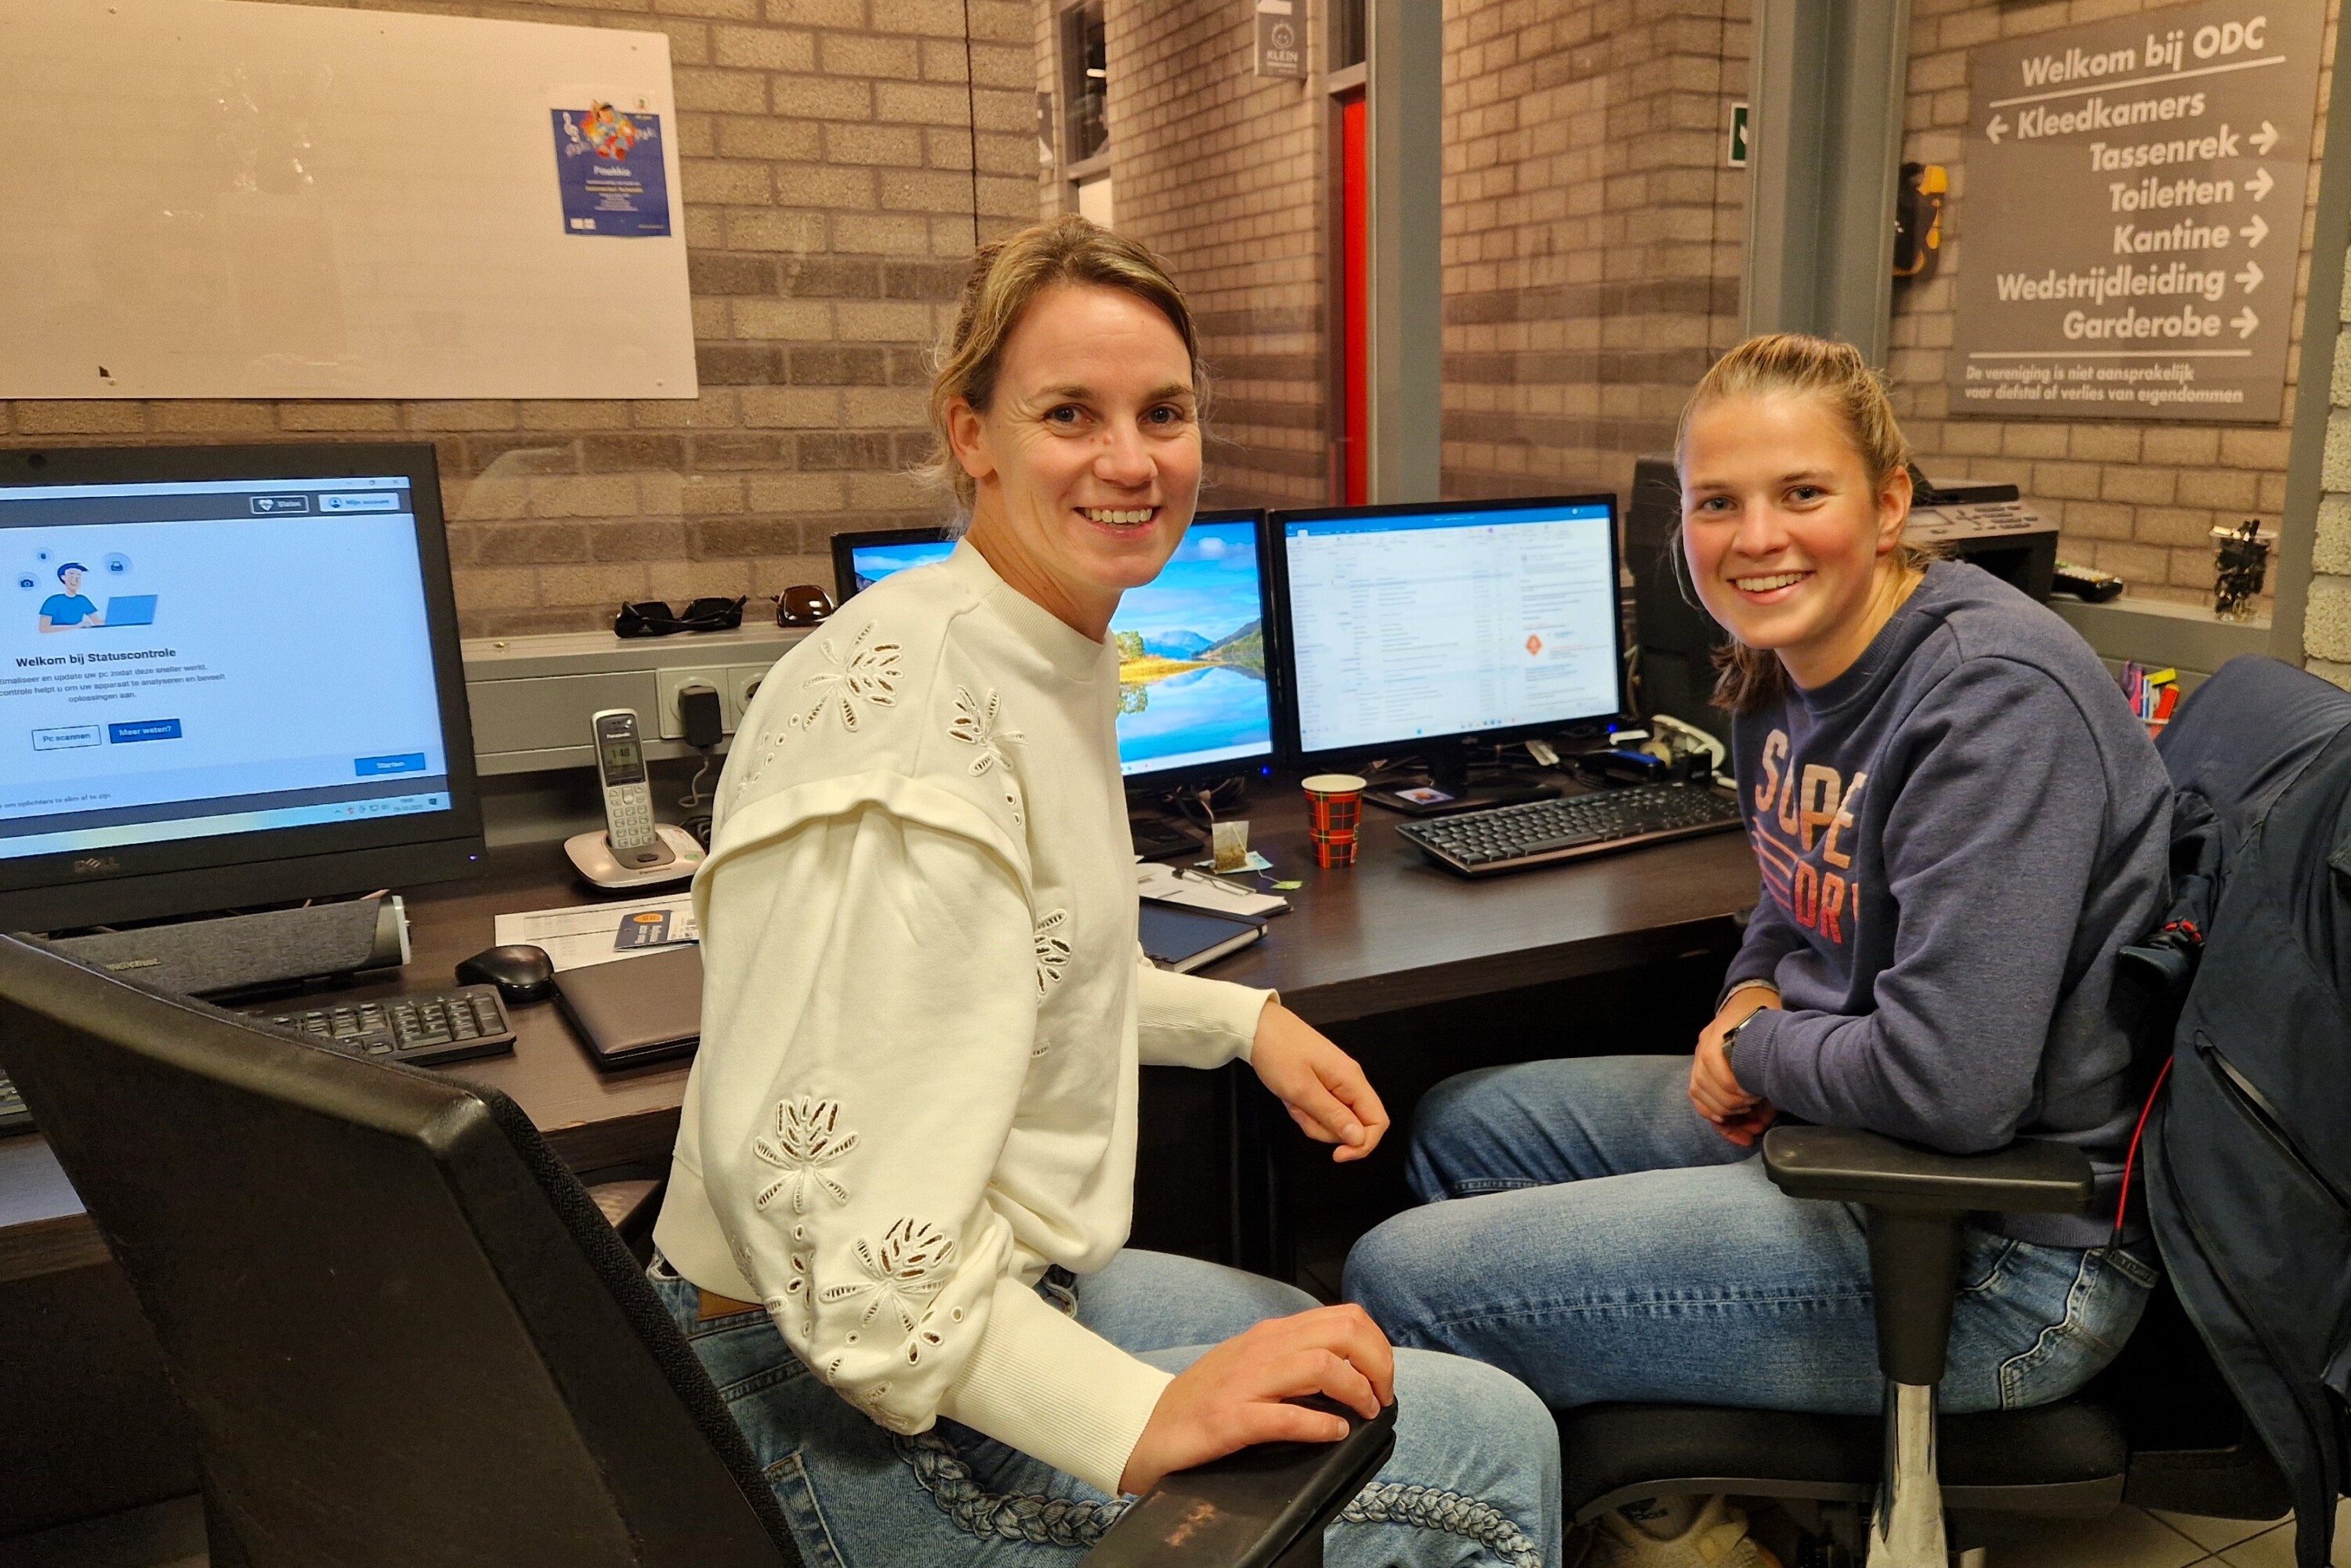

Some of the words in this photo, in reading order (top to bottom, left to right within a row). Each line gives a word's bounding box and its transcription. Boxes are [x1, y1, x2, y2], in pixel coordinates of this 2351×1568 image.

[1266, 50, 1299, 62] KLEIN
[2022, 48, 2135, 86] Welkom
[2144, 29, 2184, 71] bij
[2193, 16, 2267, 59] ODC
[2017, 92, 2206, 139] Kleedkamers
[2089, 123, 2240, 172] Tassenrek
[2109, 179, 2233, 212] Toiletten
[2113, 218, 2230, 254] Kantine
[1997, 262, 2226, 305] Wedstrijdleiding
[2063, 304, 2222, 339] Garderobe
[1965, 365, 1981, 380] De
[1985, 364, 2051, 384] vereniging
[2053, 364, 2064, 380] is
[2067, 364, 2094, 380] niet
[2096, 363, 2195, 384] aansprakelijk
[1965, 386, 1993, 399] voor
[2043, 384, 2059, 400] of
[2061, 383, 2104, 400] verlies
[2108, 388, 2134, 400] van
[2137, 384, 2244, 406] eigendommen
[16, 657, 67, 667] Welkom
[70, 654, 85, 664] bij
[88, 649, 176, 662] Statuscontrole
[54, 672, 82, 682] update
[155, 665, 182, 674] sneller
[94, 680, 130, 690] apparaat
[141, 677, 184, 686] analyseren
[197, 673, 226, 682] beveelt
[68, 693, 118, 703] oplossingen
[56, 733, 91, 742] scannen
[118, 728, 142, 737] Meer
[142, 725, 172, 734] weten?
[17, 798, 54, 808] oplichters
